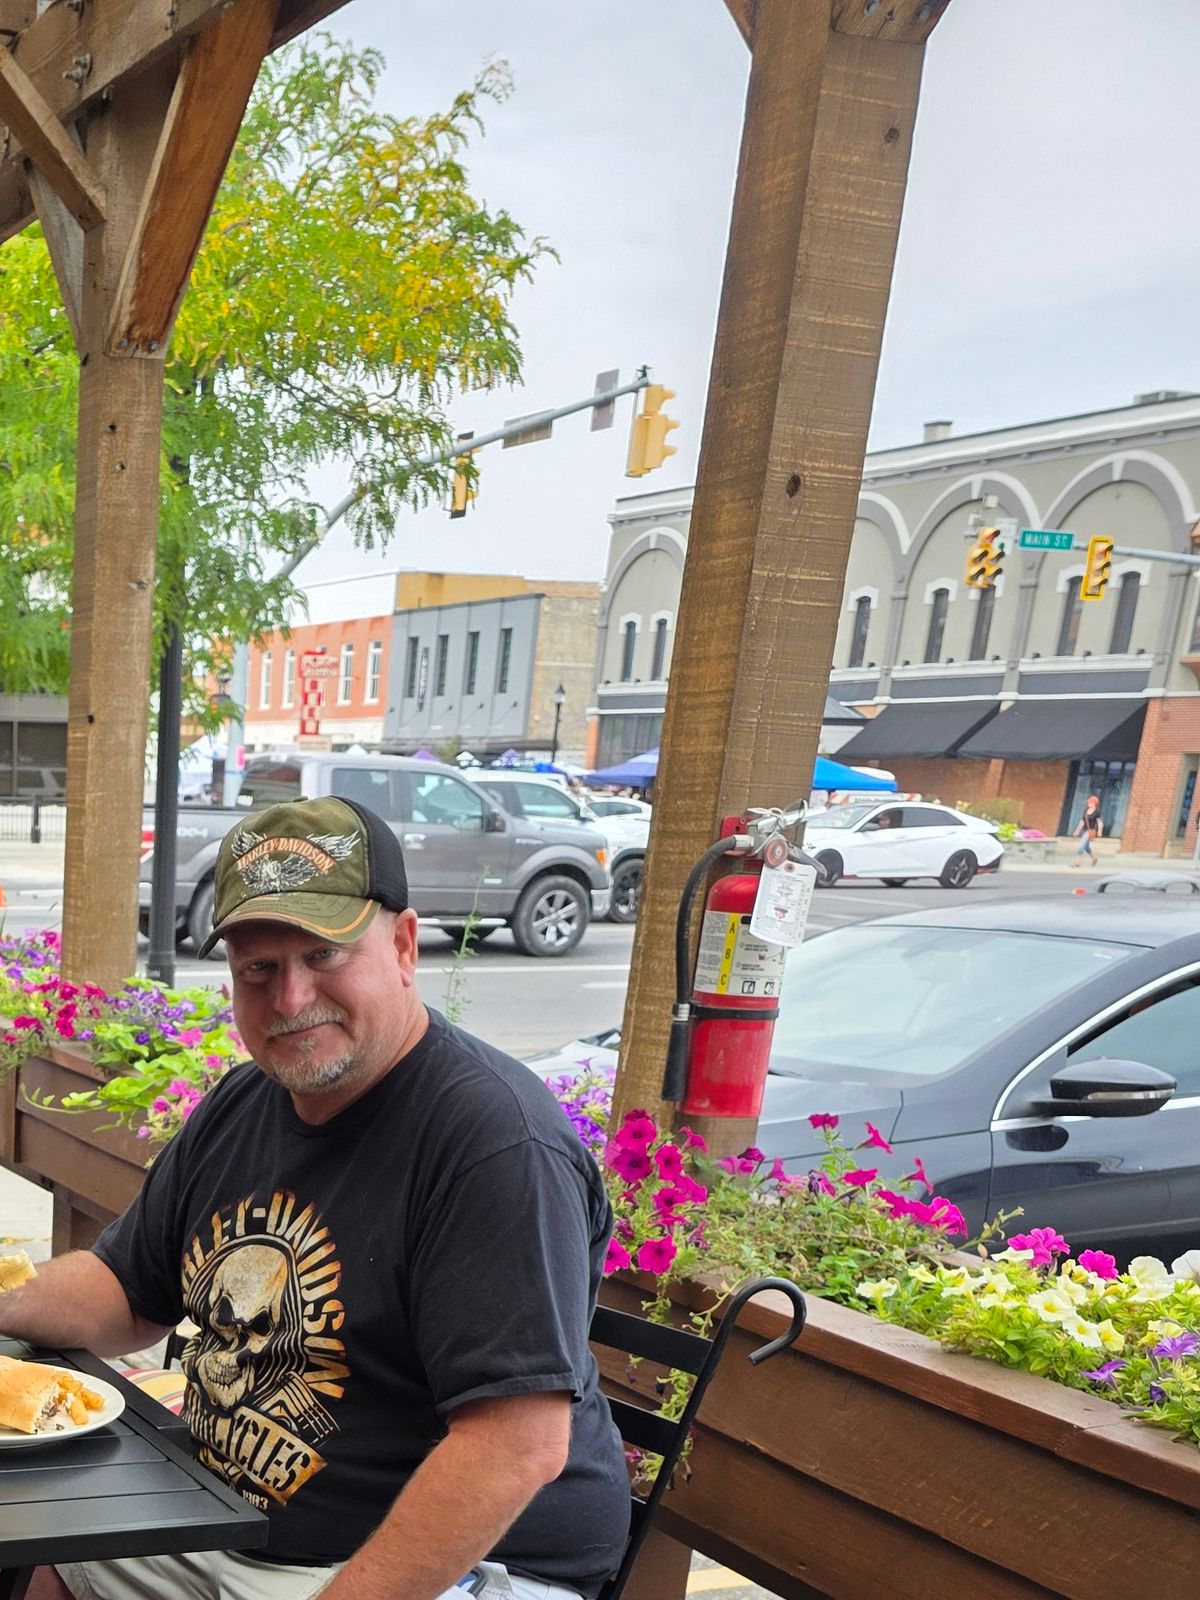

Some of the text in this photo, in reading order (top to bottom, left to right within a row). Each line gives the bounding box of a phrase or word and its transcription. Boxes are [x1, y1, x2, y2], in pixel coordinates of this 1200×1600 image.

[1025, 532, 1050, 546] MAIN
[237, 837, 335, 875] HARLEY-DAVIDSON
[720, 922, 735, 986] A B C
